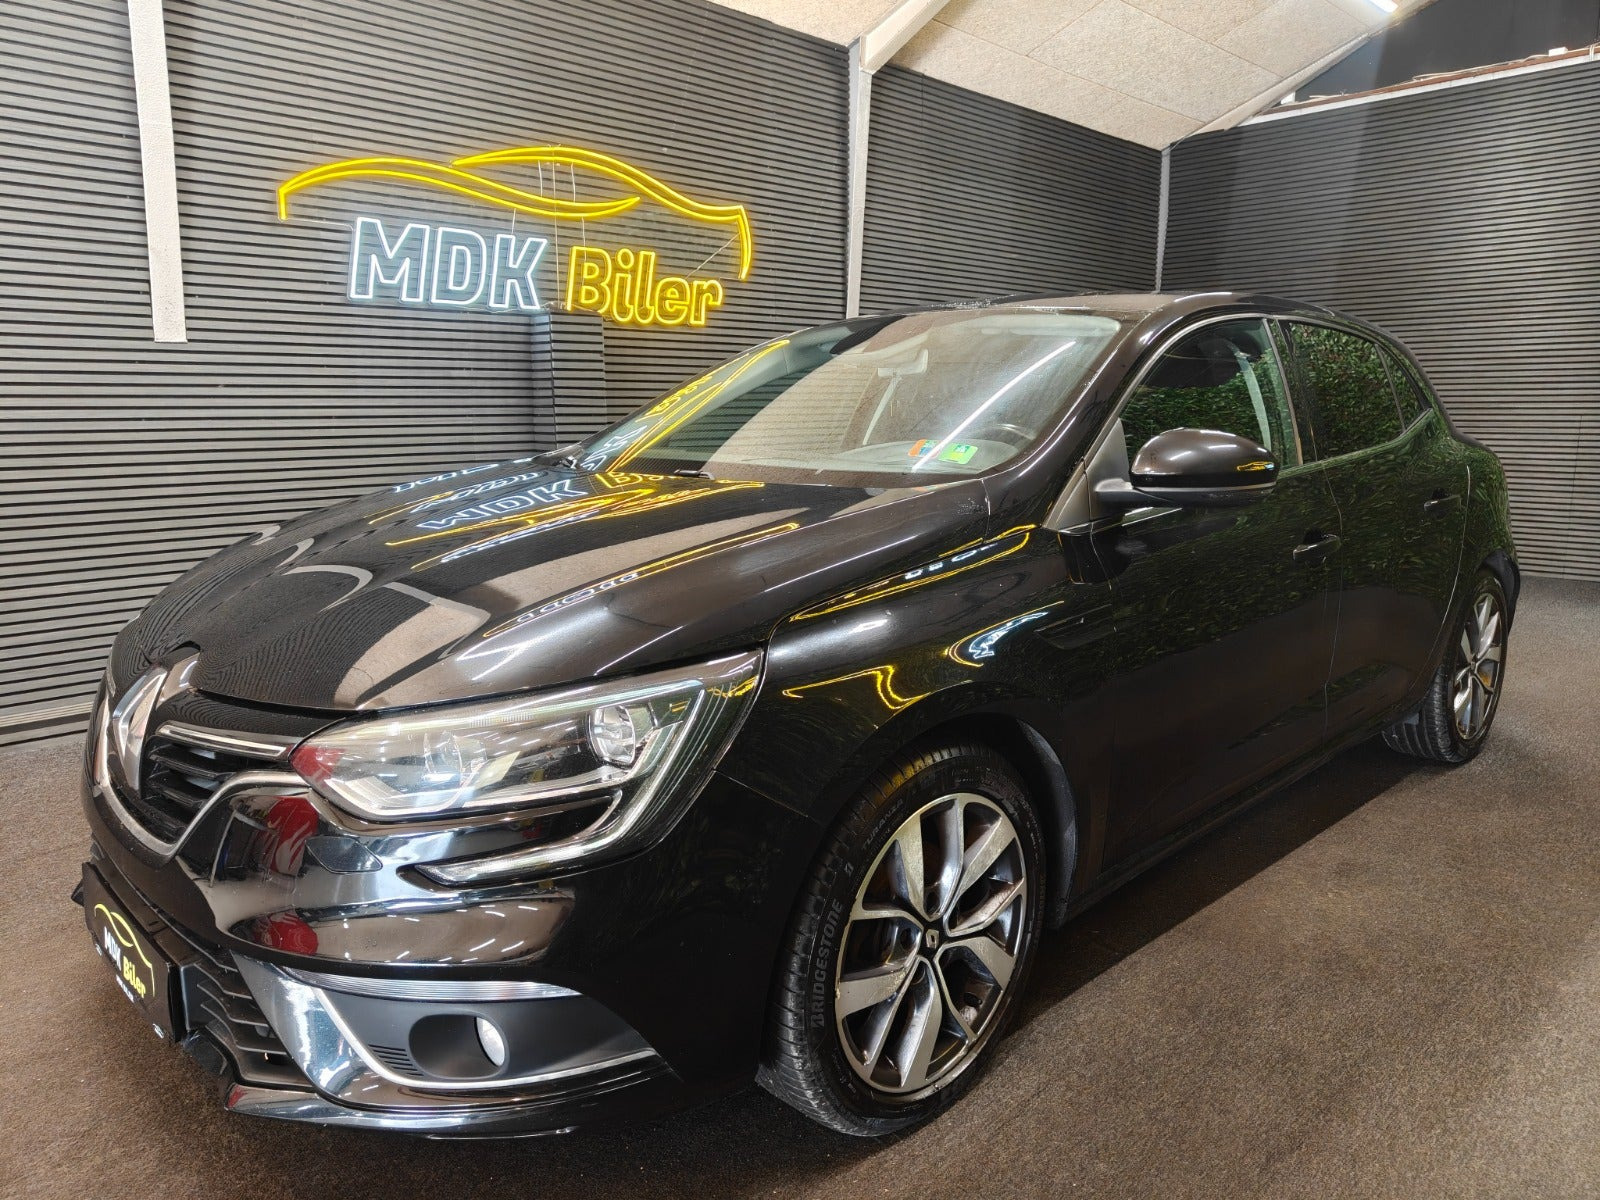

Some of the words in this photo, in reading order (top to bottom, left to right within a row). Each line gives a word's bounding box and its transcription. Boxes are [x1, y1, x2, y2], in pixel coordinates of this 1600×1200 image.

[349, 216, 548, 311] MDK
[566, 246, 724, 327] Biler
[862, 798, 904, 851] TURANZA
[104, 925, 122, 972] MDK
[122, 955, 147, 999] Biler
[810, 898, 844, 1028] BRIDGESTONE
